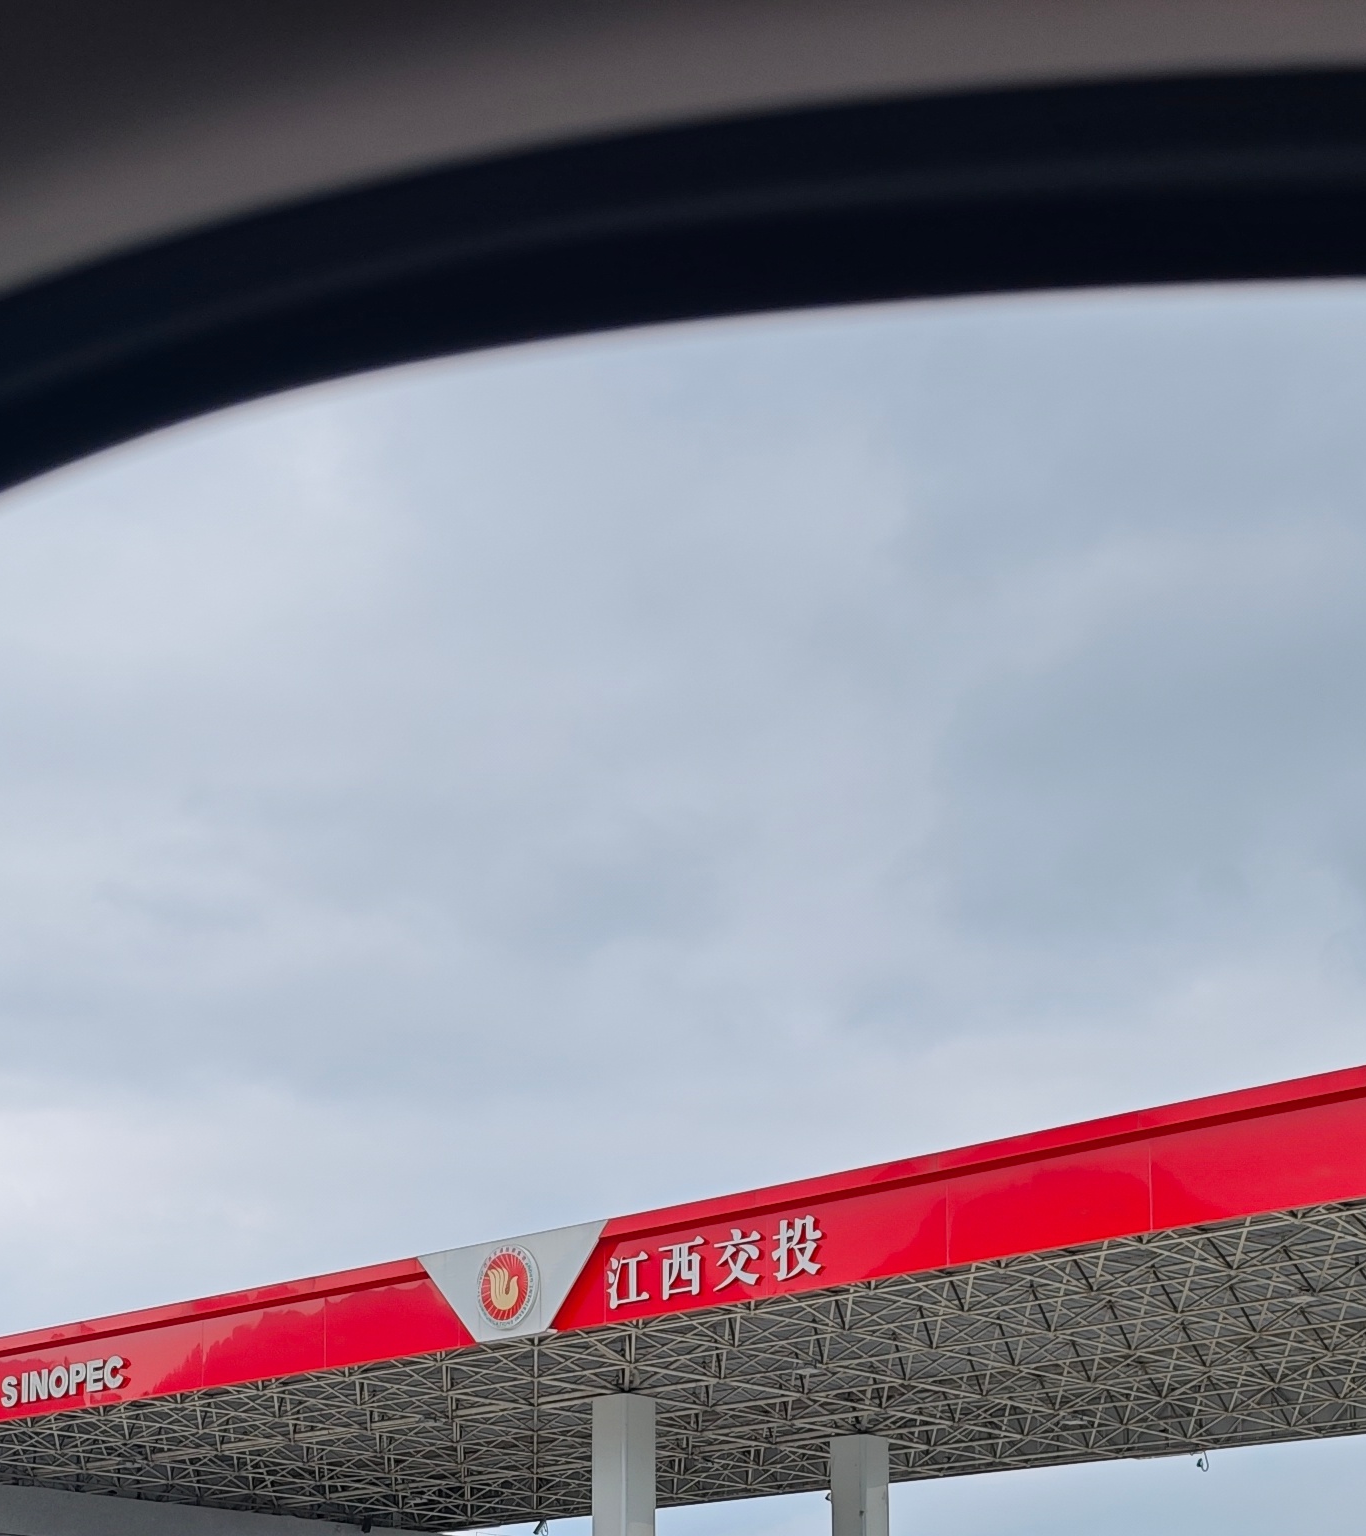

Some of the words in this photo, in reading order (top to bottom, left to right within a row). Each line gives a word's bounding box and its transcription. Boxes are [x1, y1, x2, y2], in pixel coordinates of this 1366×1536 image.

[606, 1214, 823, 1310] 江西交投
[0, 1355, 124, 1408] SINOPEC
